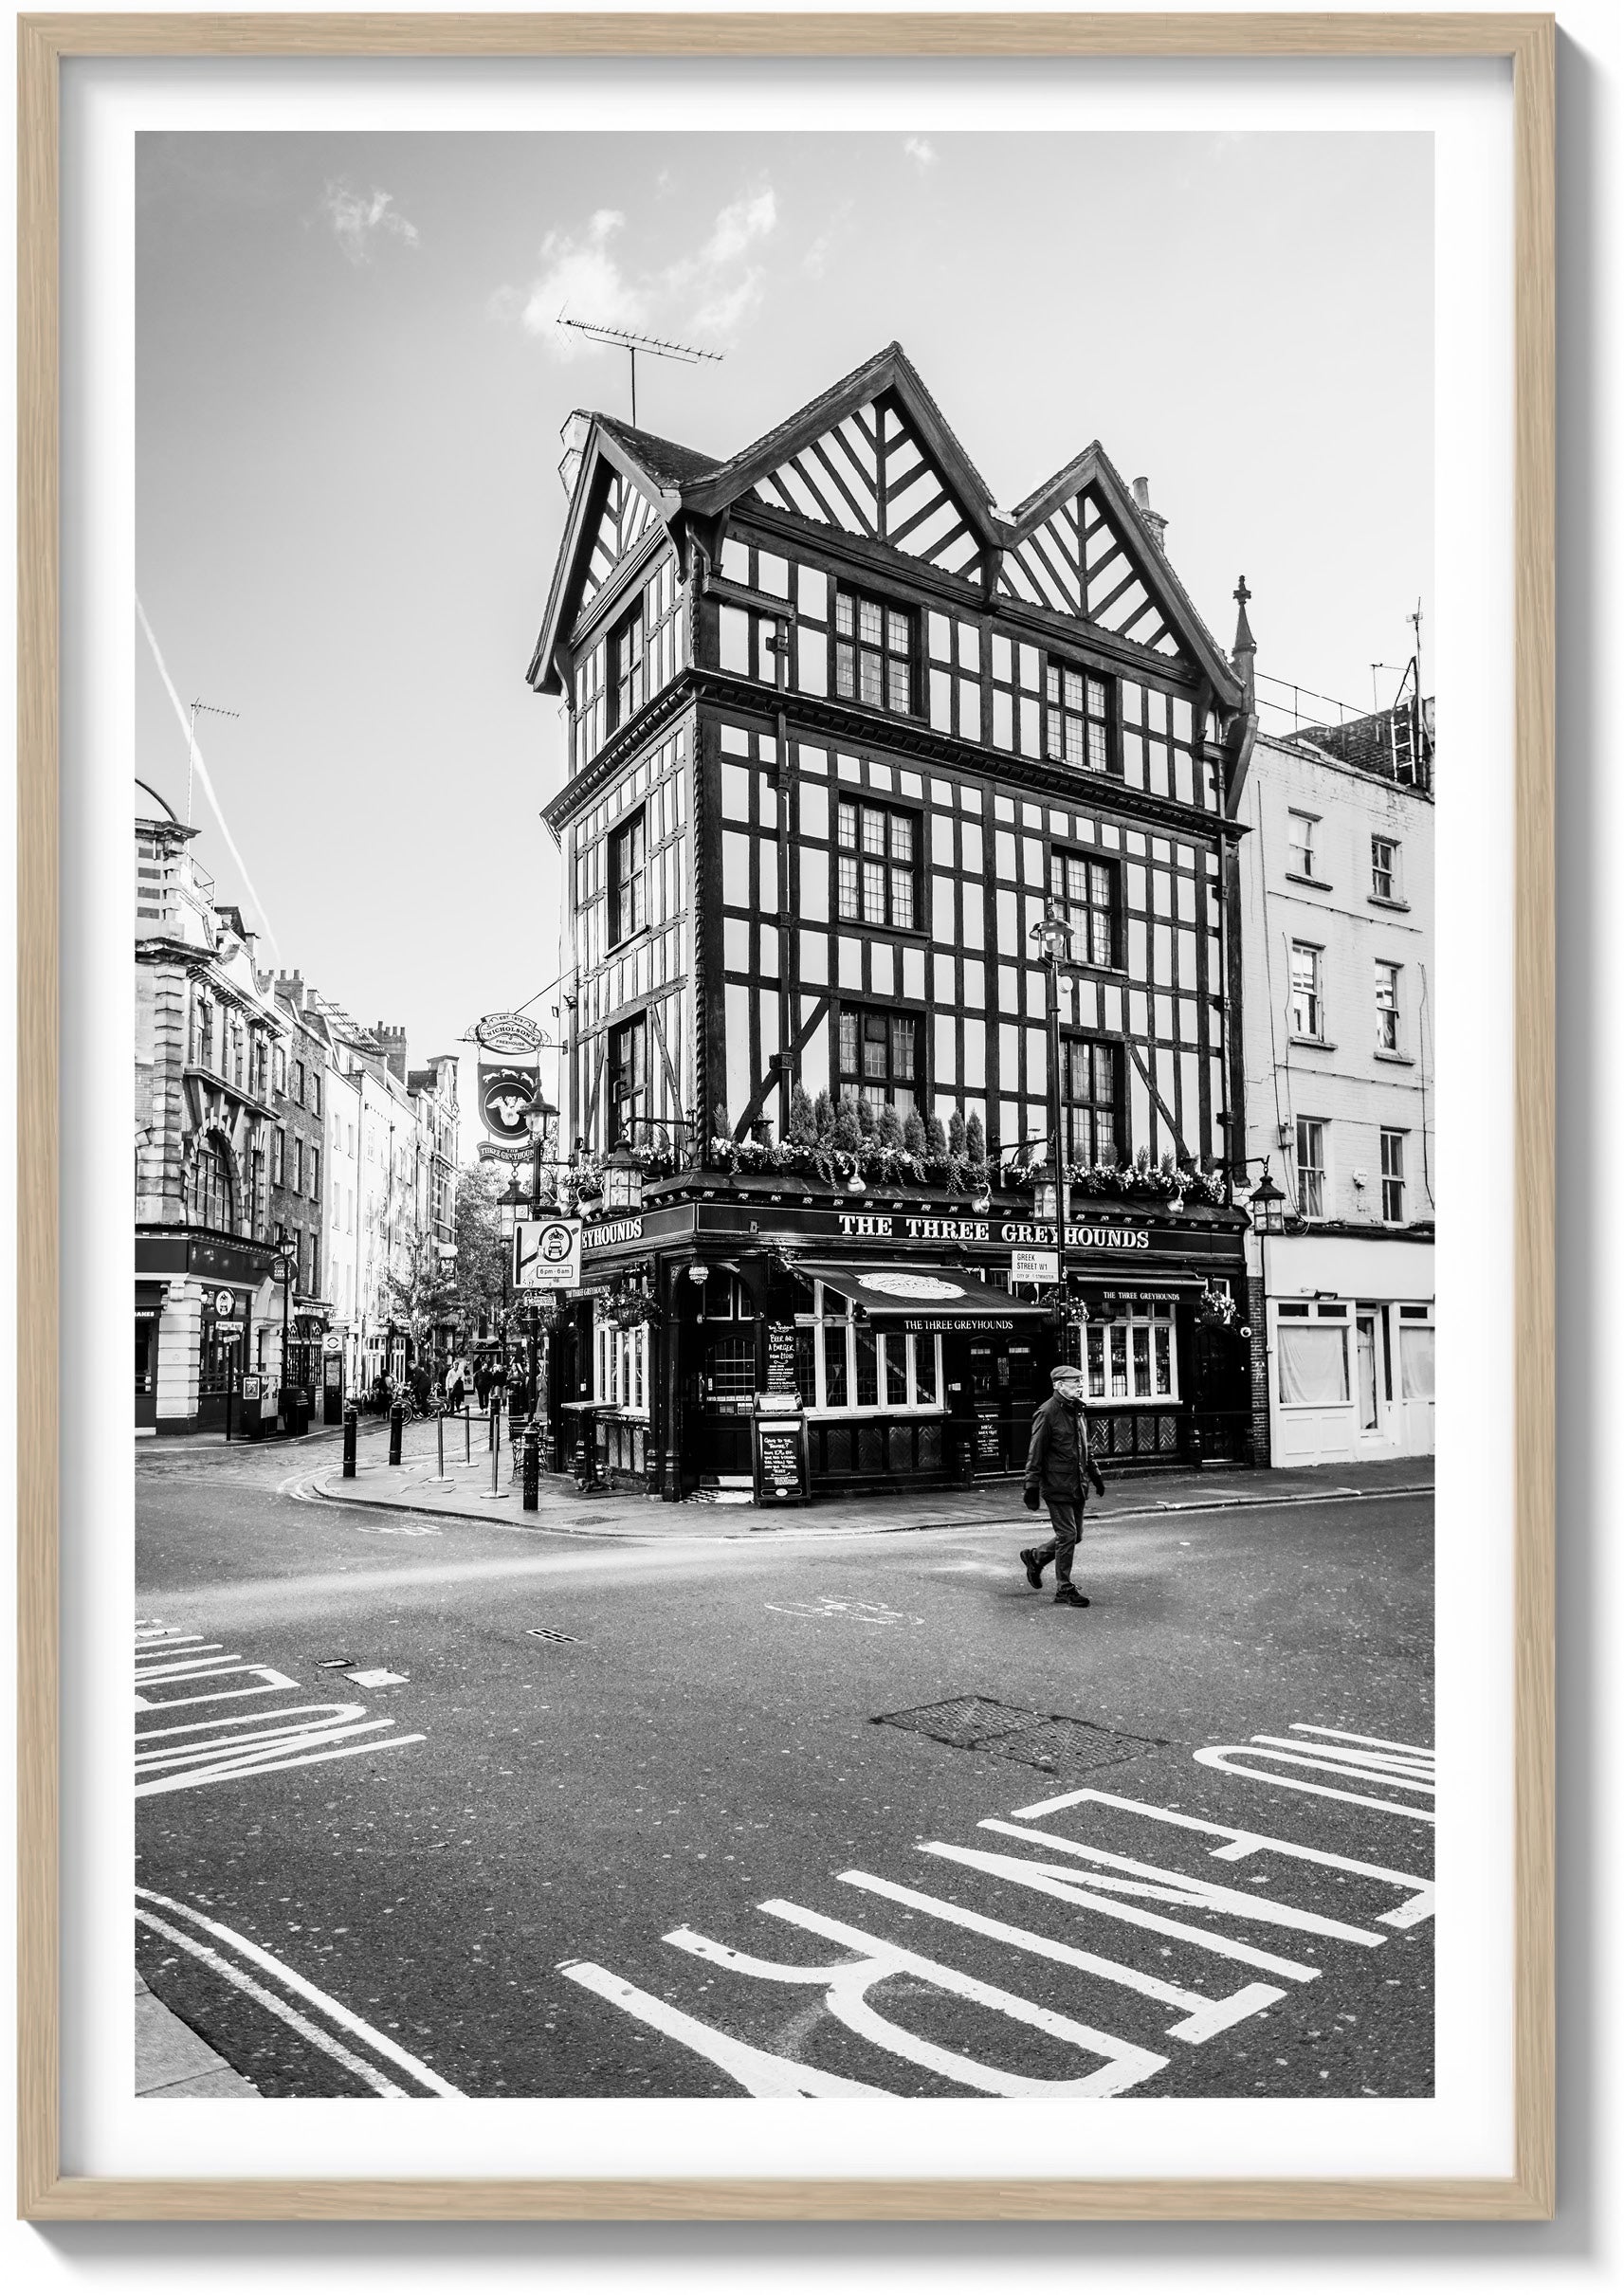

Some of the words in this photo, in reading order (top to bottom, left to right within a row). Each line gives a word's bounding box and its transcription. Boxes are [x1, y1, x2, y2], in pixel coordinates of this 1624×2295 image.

[486, 1026, 538, 1042] NICHOLSON'S
[481, 1146, 502, 1158] THREE
[501, 1149, 535, 1161] GREYHOUN
[581, 1217, 643, 1249] EYHOUNDS
[839, 1214, 893, 1237] THE
[905, 1217, 990, 1241] THREE
[1001, 1224, 1150, 1249] GREYHOUNDS
[1016, 1253, 1036, 1262] GREEK
[1016, 1262, 1038, 1270] STREET
[1103, 1291, 1116, 1300] THE
[1118, 1291, 1138, 1300] THREE
[1140, 1292, 1180, 1301] GREYHOUNDS
[903, 1320, 923, 1330] THE
[923, 1320, 954, 1330] THREE
[954, 1320, 1013, 1330] GREYHOUNDS
[770, 1334, 785, 1343] BEER
[773, 1343, 795, 1353] BURGER
